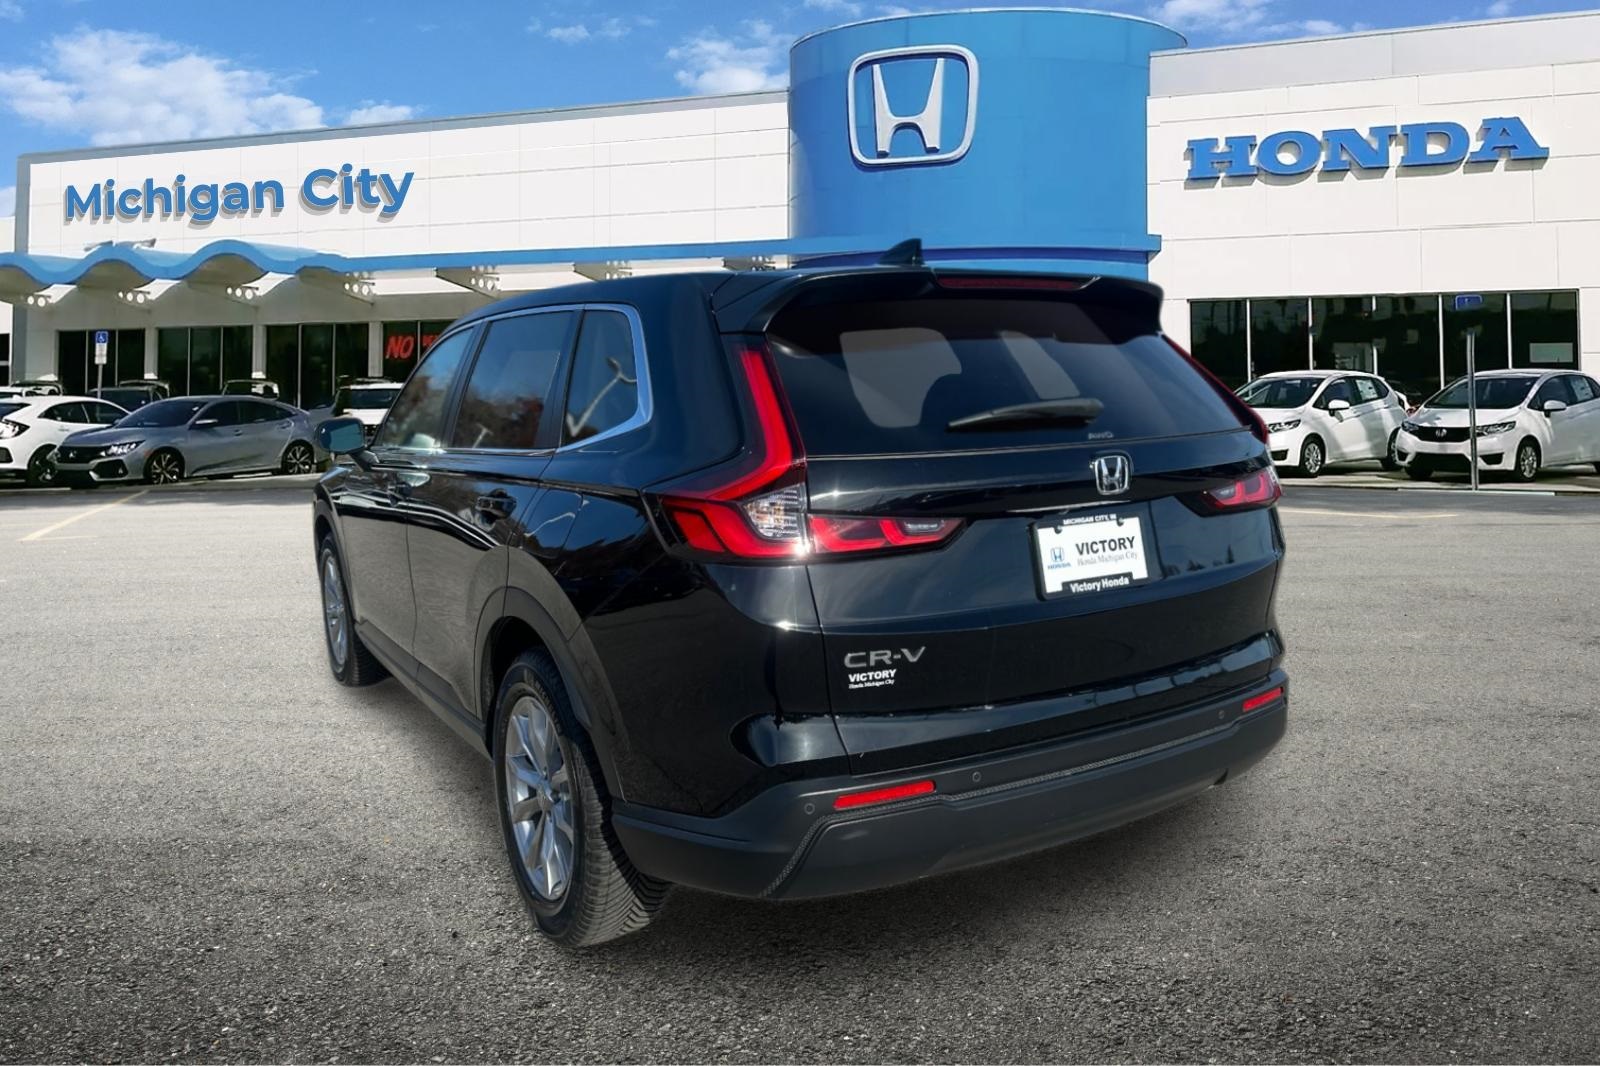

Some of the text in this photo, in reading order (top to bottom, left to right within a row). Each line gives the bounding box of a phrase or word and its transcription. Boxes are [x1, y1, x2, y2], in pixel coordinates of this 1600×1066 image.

[1185, 116, 1550, 182] HONDA
[65, 162, 415, 225] Michigan City
[385, 334, 415, 360] NO
[1075, 536, 1135, 556] VICTORY
[1098, 553, 1125, 566] Michigan
[1125, 550, 1138, 561] City
[1070, 576, 1129, 593] Victory Honda
[844, 646, 926, 668] CR-V
[848, 669, 896, 682] VICTORY
